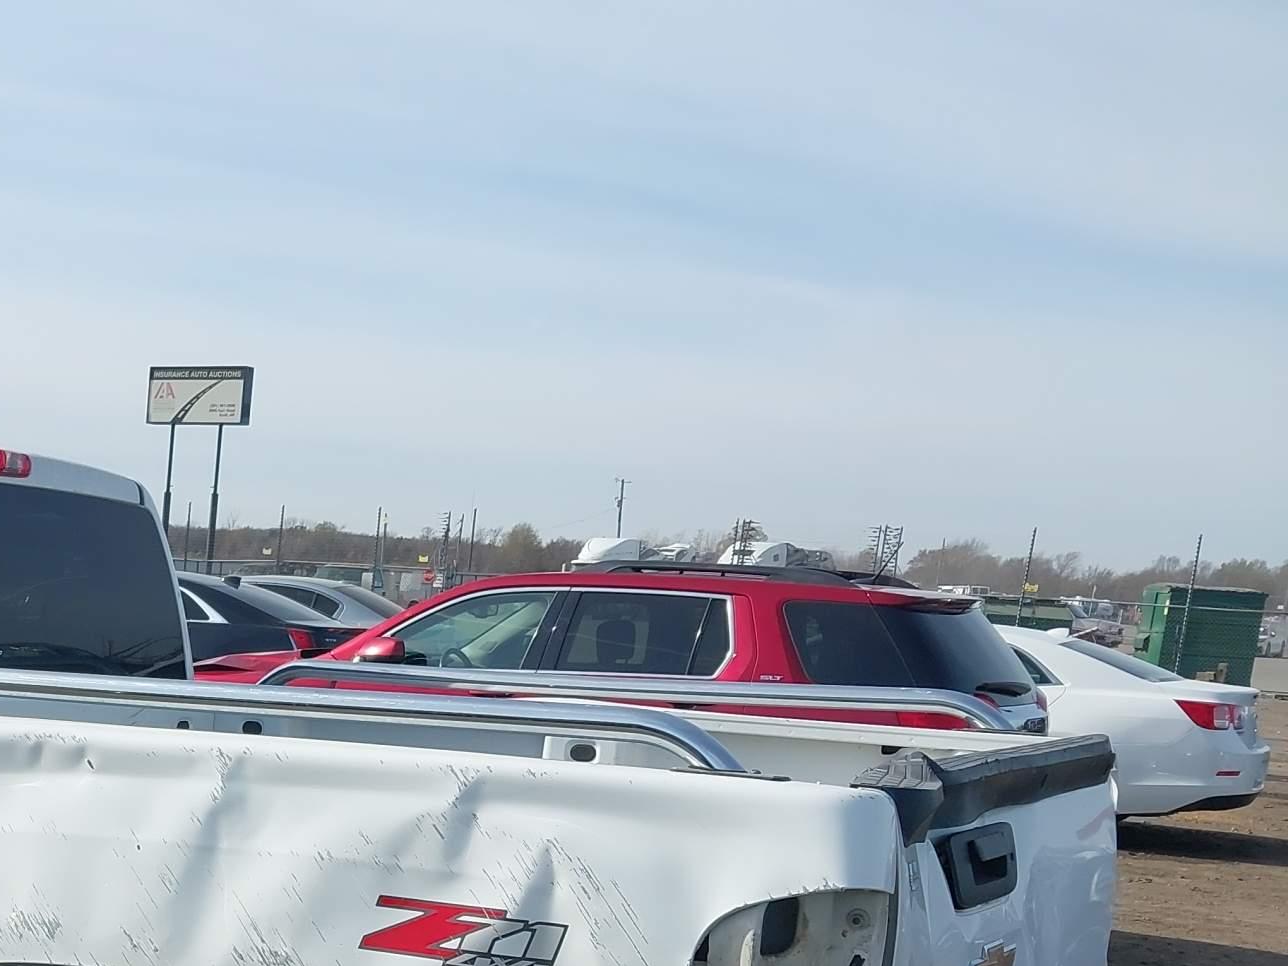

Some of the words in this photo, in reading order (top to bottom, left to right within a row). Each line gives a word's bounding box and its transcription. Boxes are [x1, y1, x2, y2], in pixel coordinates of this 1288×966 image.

[153, 370, 189, 378] INSURANCE
[190, 370, 208, 378] AUTO
[208, 370, 242, 378] AUCTIONS
[359, 895, 569, 963] Z71
